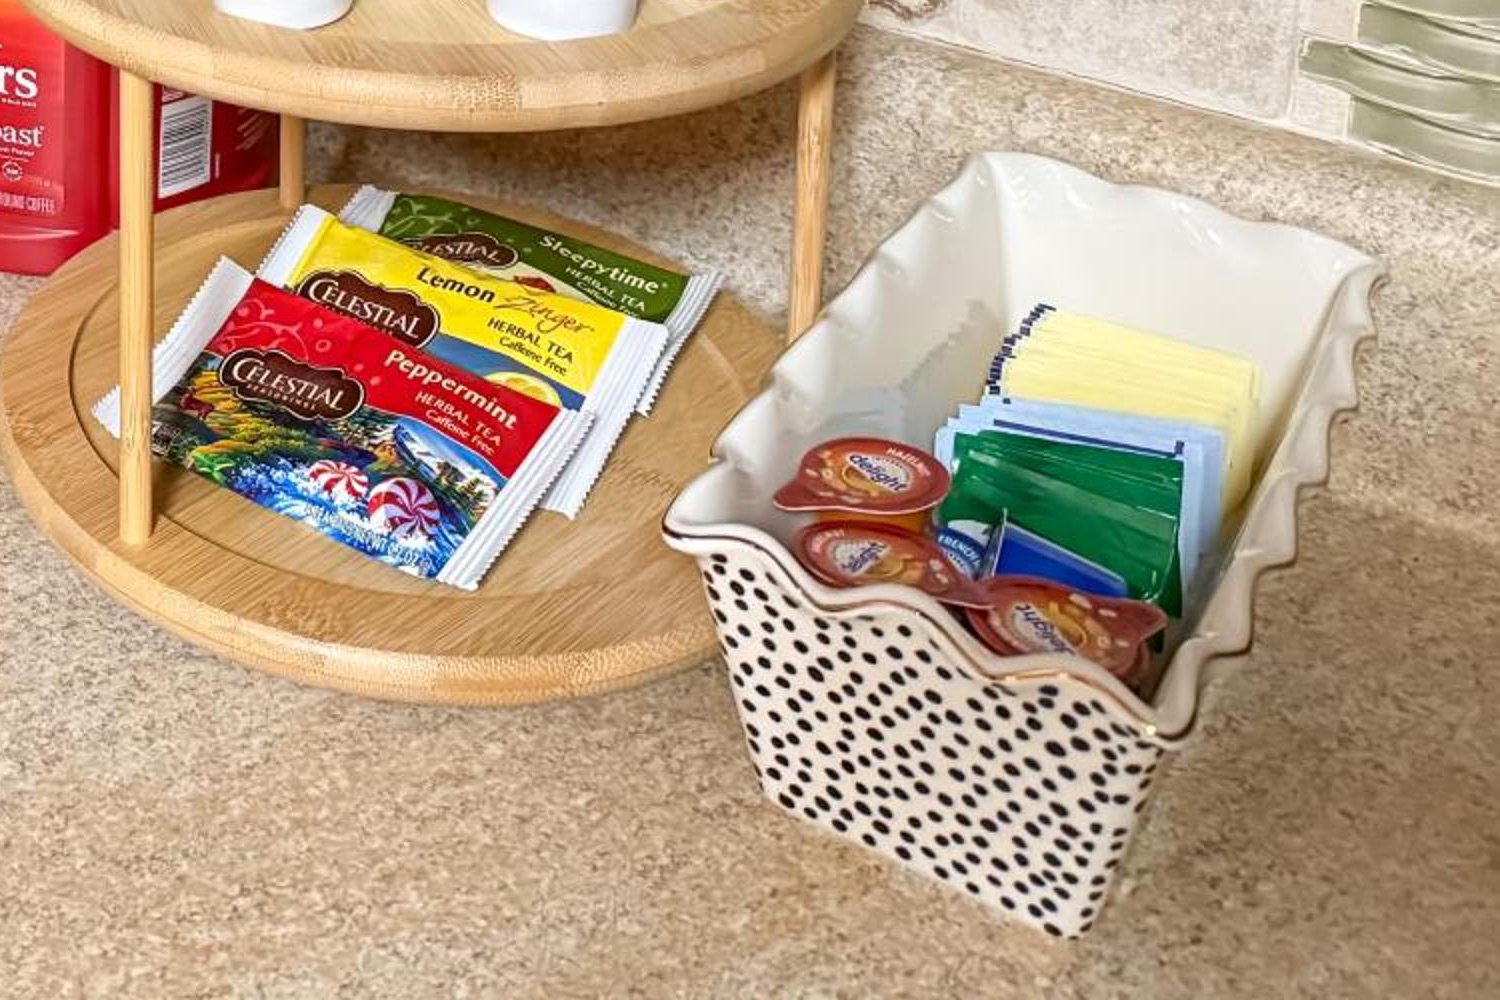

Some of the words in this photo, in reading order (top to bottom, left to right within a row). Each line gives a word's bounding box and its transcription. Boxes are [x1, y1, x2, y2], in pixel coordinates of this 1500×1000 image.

[539, 235, 659, 294] Sleepytime
[565, 266, 616, 298] HERBAL
[620, 293, 645, 312] TEA
[308, 278, 419, 339] CELESTIAL
[416, 267, 496, 303] Lemon
[494, 294, 590, 335] Zinger
[487, 317, 542, 347] HERBAL
[548, 341, 573, 364] TEA
[499, 336, 542, 363] Caffeine
[543, 357, 567, 376] Free
[233, 357, 344, 410] CELESTIAL
[384, 350, 518, 430] Peppermint
[415, 391, 469, 426] HERBAL
[475, 422, 501, 447] TEA
[425, 408, 470, 439] Caffeine
[471, 434, 495, 455] Free
[849, 454, 909, 492] delight
